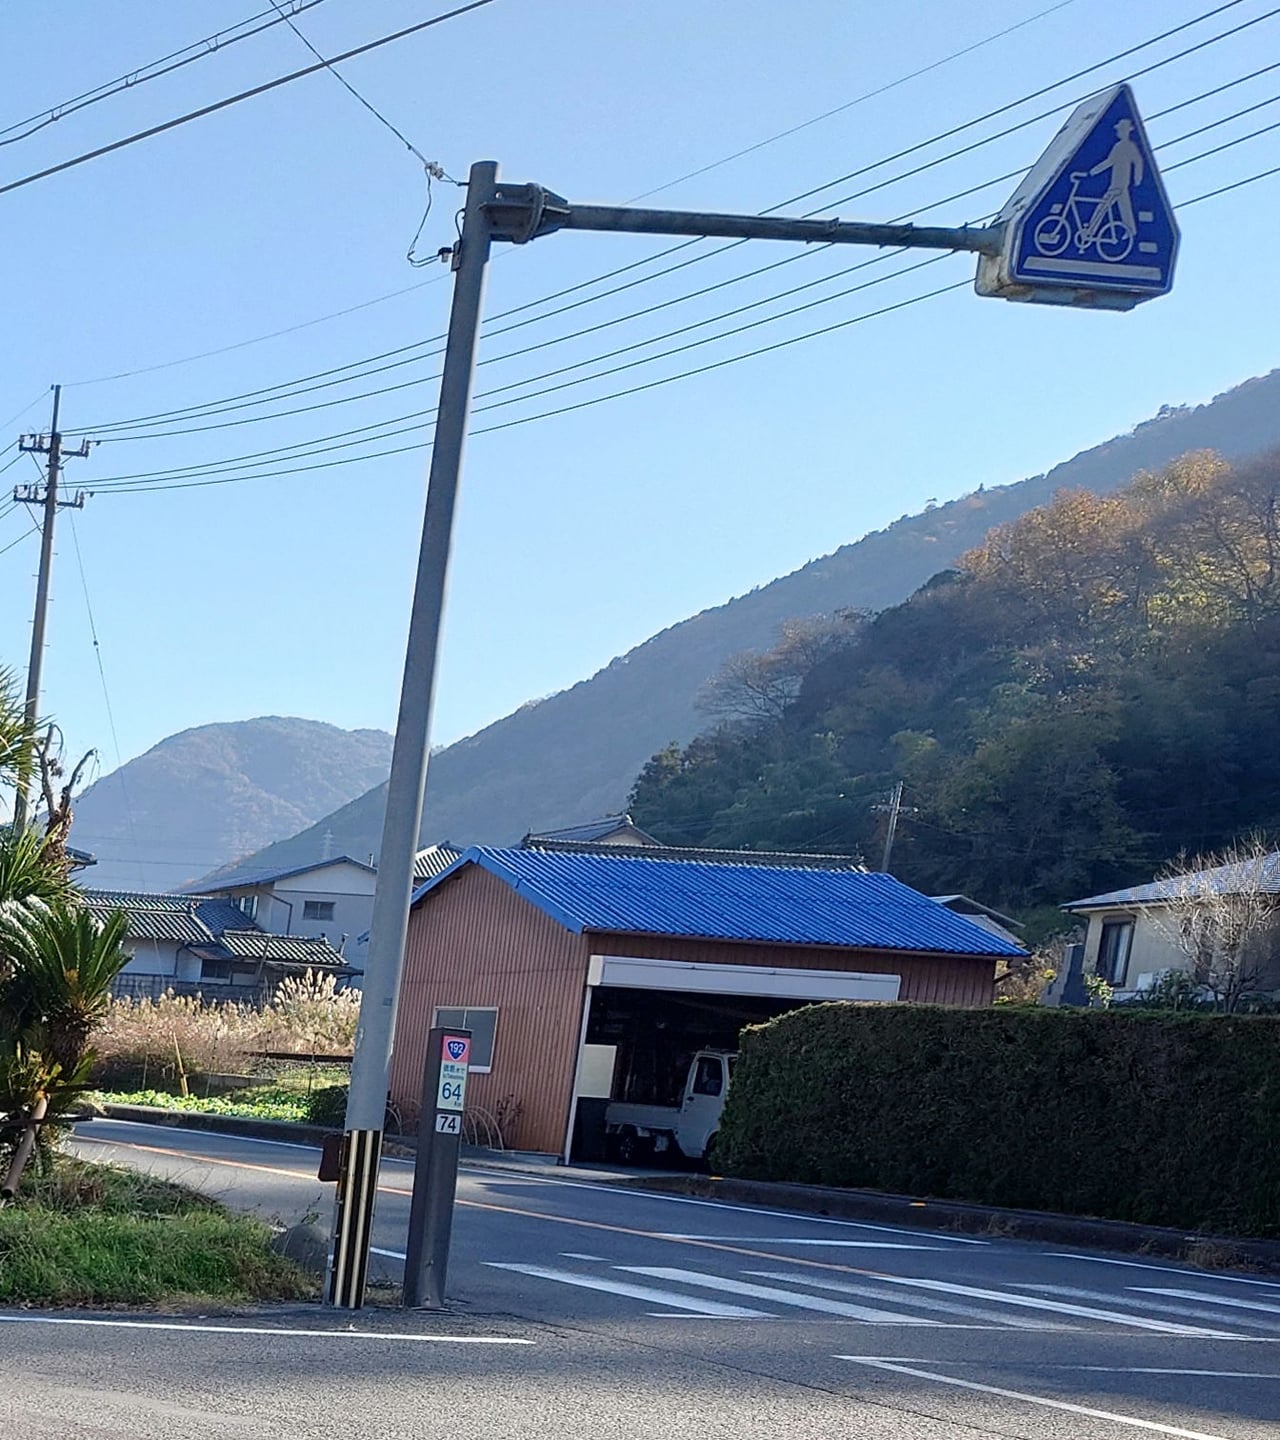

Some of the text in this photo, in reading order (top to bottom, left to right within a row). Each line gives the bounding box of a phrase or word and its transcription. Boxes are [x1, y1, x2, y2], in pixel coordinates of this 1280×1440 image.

[449, 1042, 464, 1054] 192
[442, 1082, 461, 1100] 64
[440, 1116, 456, 1132] 74
